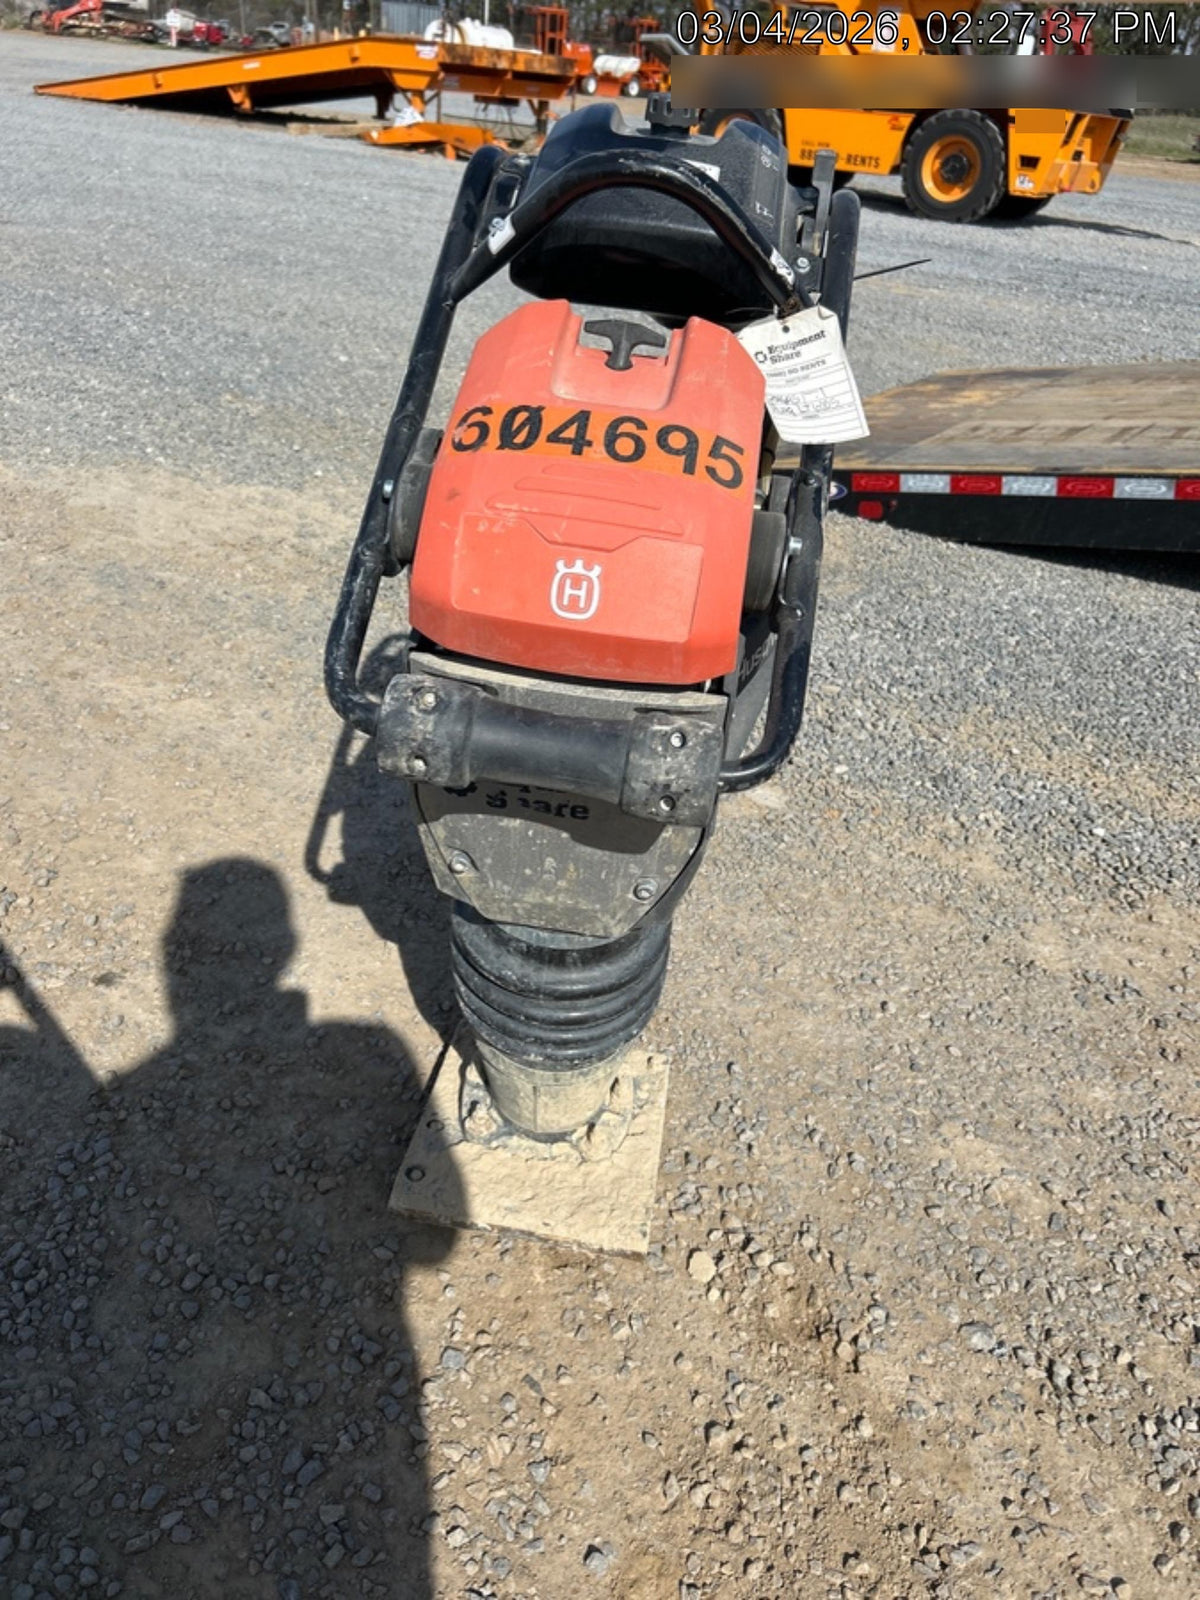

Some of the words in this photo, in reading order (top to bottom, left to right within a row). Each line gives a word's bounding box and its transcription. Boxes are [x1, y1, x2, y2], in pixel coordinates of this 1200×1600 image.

[767, 330, 826, 354] Equipment
[769, 350, 802, 364] Share
[451, 404, 746, 490] 604695
